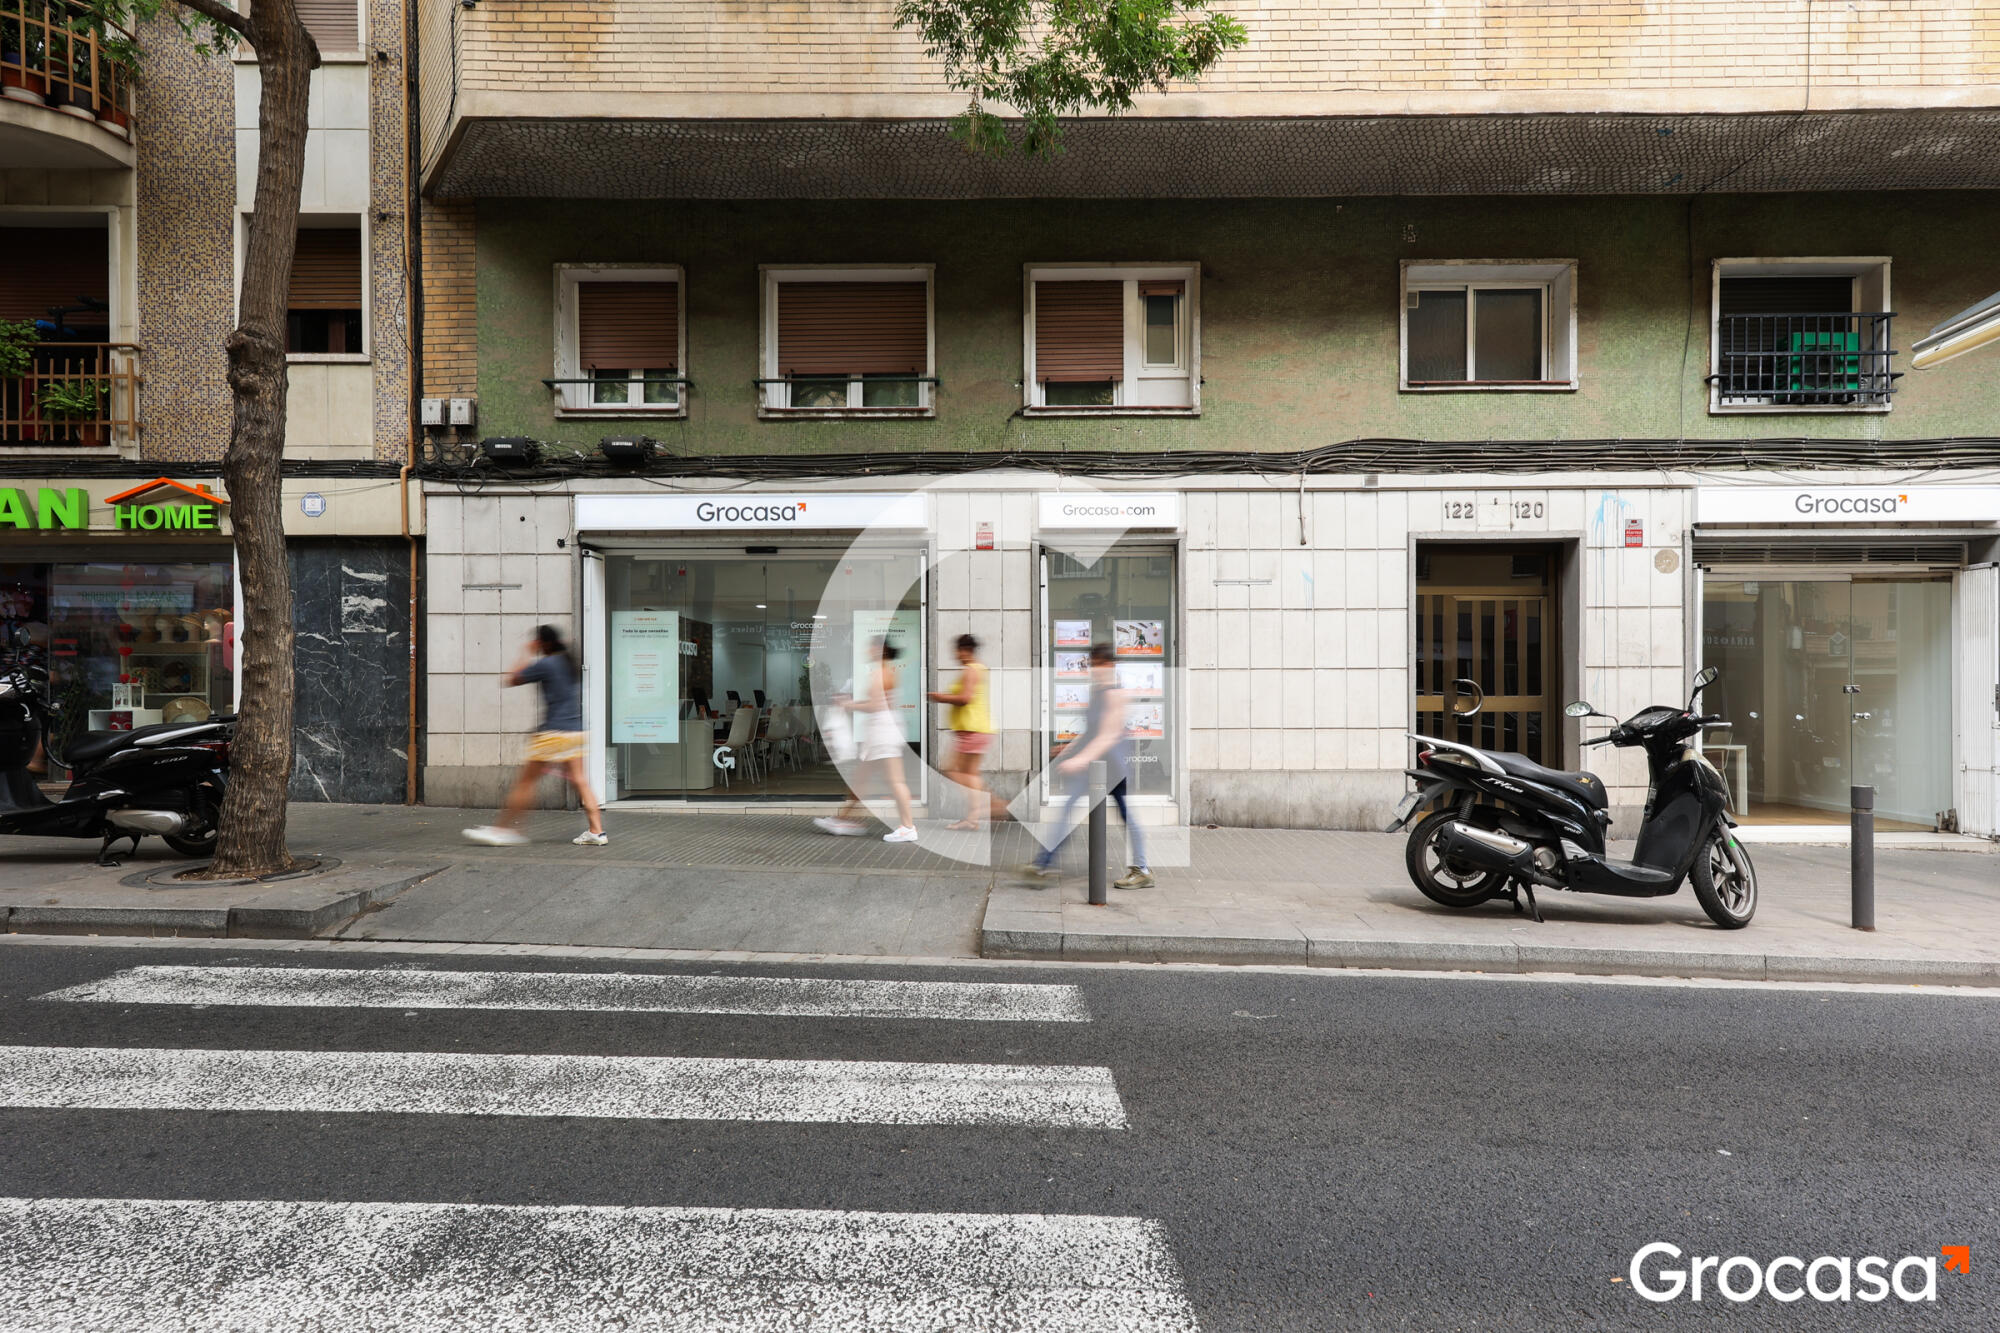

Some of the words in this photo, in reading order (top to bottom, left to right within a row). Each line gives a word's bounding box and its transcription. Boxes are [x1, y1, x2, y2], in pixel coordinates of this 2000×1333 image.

[697, 502, 796, 522] Grocasa
[1445, 502, 1474, 519] 122
[1514, 501, 1544, 519] 120
[1795, 494, 1897, 513] Grocasa
[115, 505, 214, 529] HOME
